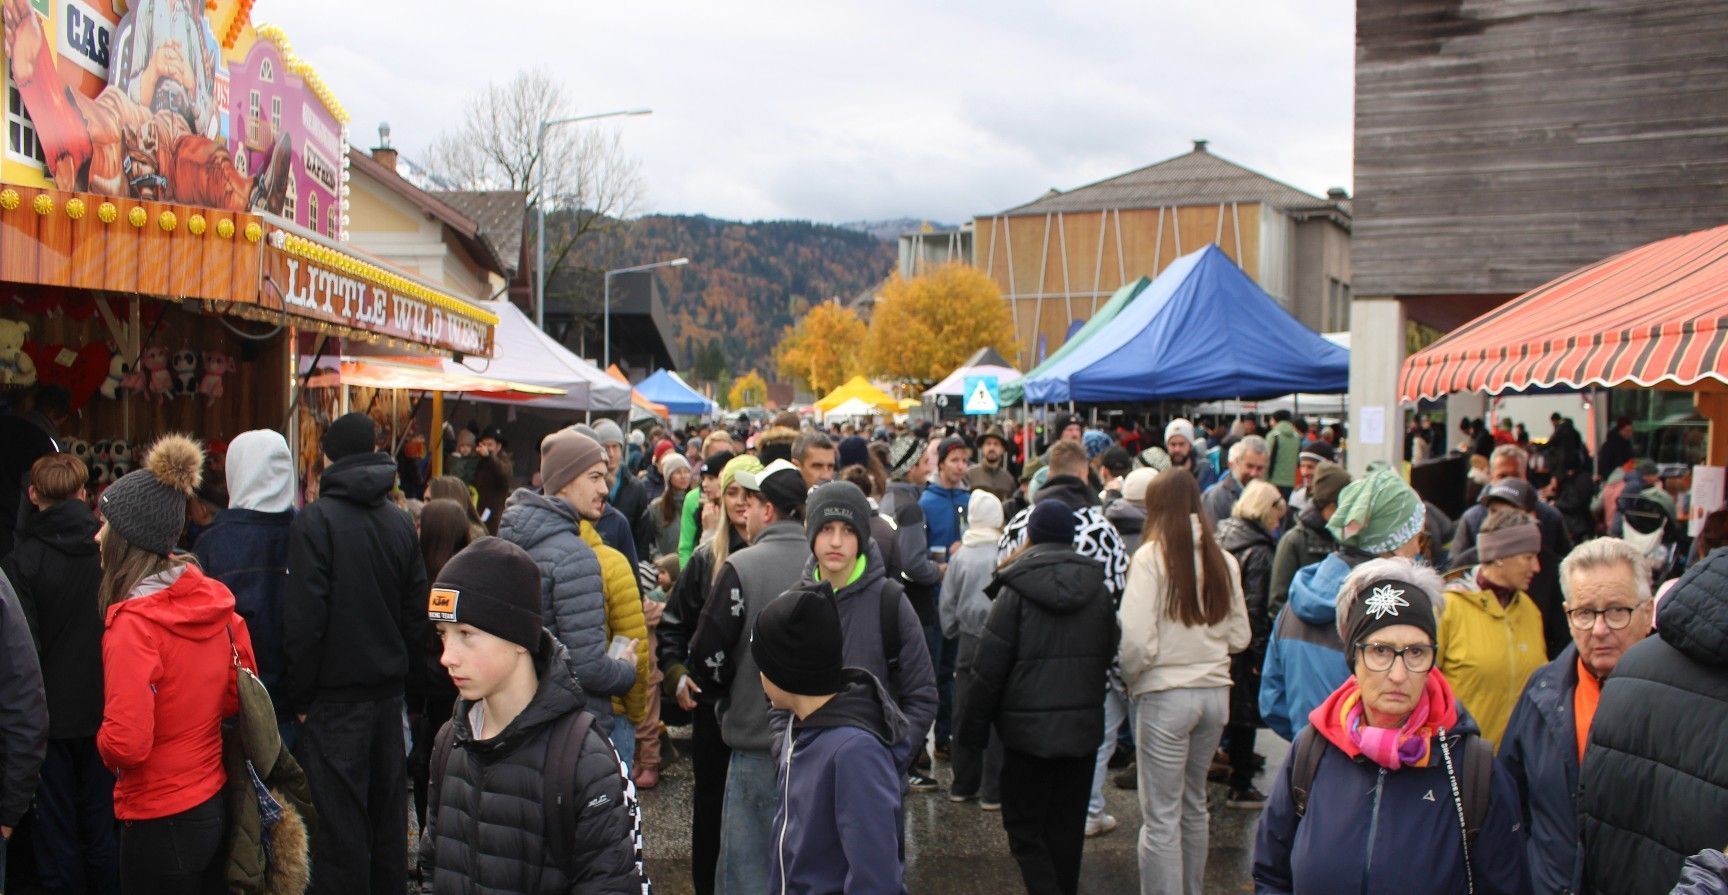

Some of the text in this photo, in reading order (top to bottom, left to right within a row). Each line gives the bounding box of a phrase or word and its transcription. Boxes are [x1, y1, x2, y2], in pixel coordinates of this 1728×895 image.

[285, 257, 487, 352] LITTLE WILD WEST
[432, 595, 450, 607] KTM
